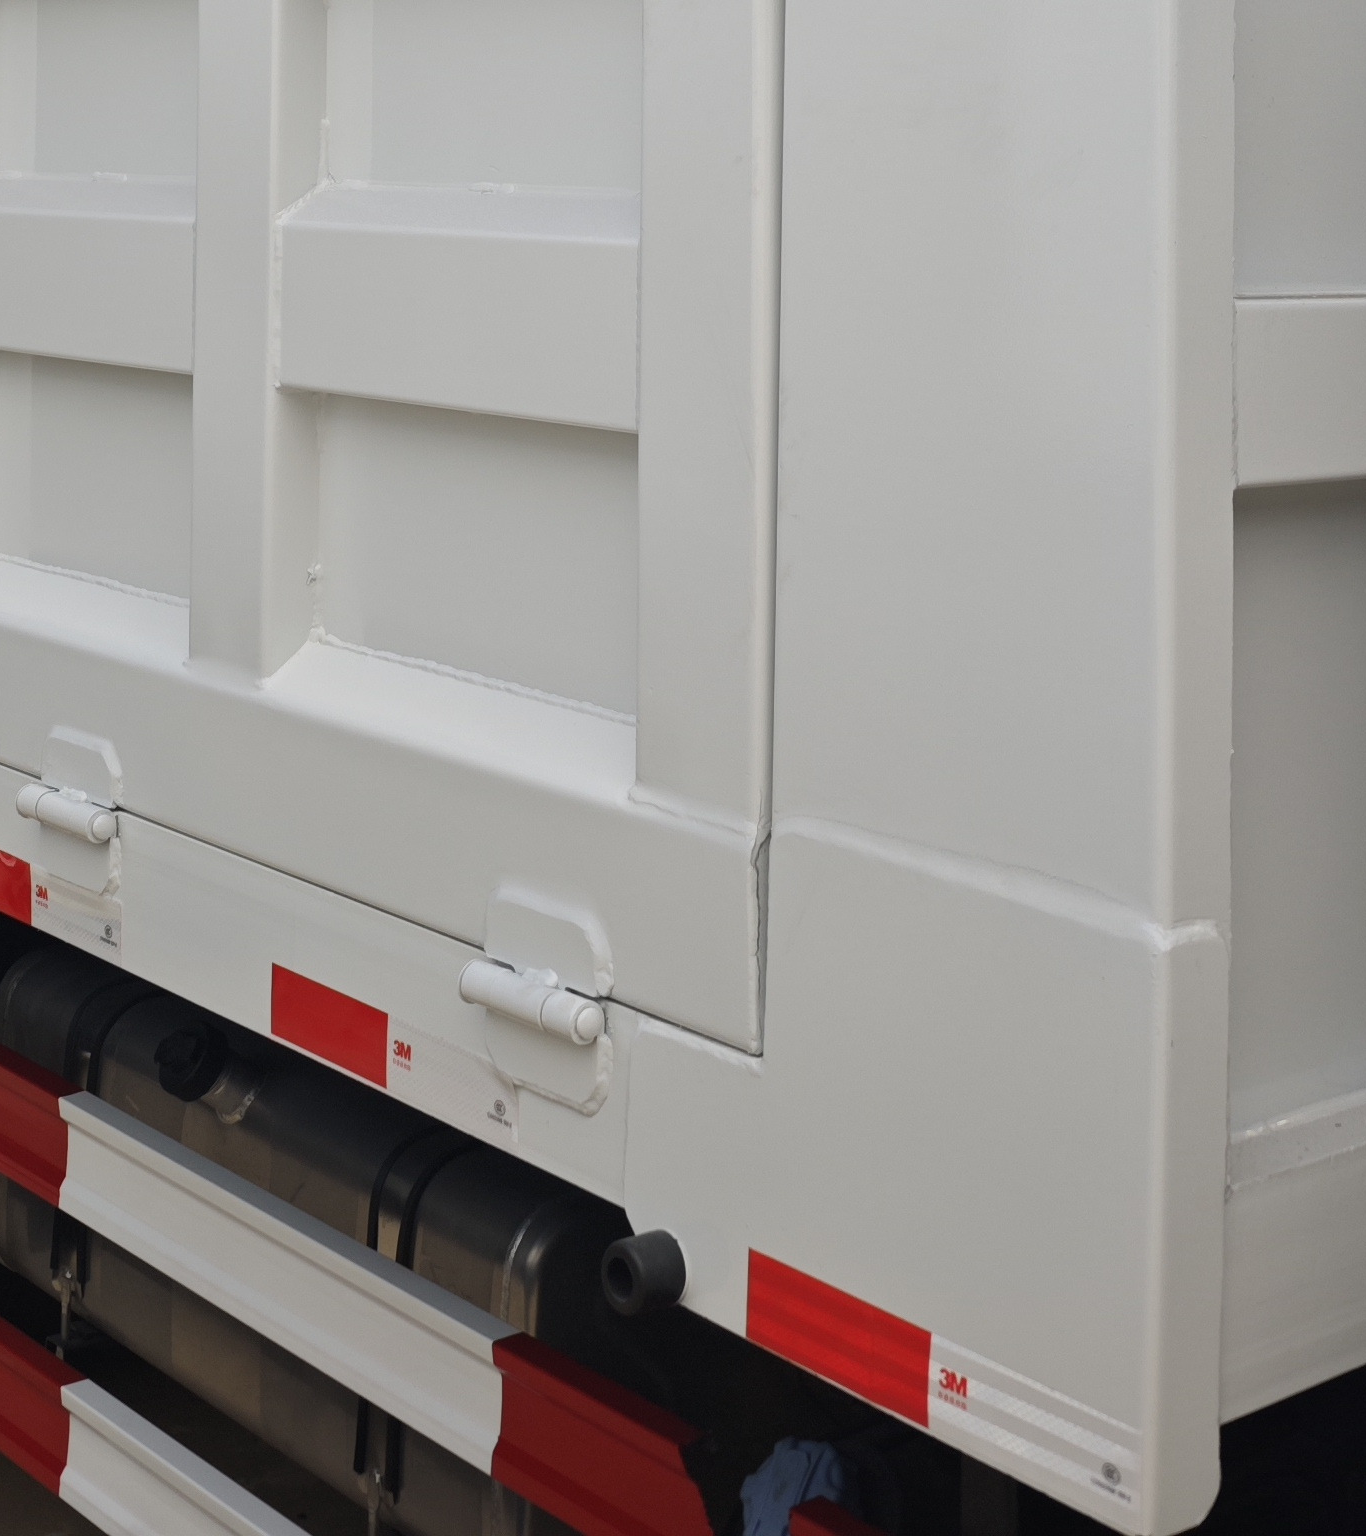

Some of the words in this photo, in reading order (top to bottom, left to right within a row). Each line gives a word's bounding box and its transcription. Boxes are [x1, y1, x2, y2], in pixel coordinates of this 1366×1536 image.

[36, 884, 48, 901] 3M
[393, 1040, 411, 1061] 3M
[939, 1368, 967, 1398] 3M
